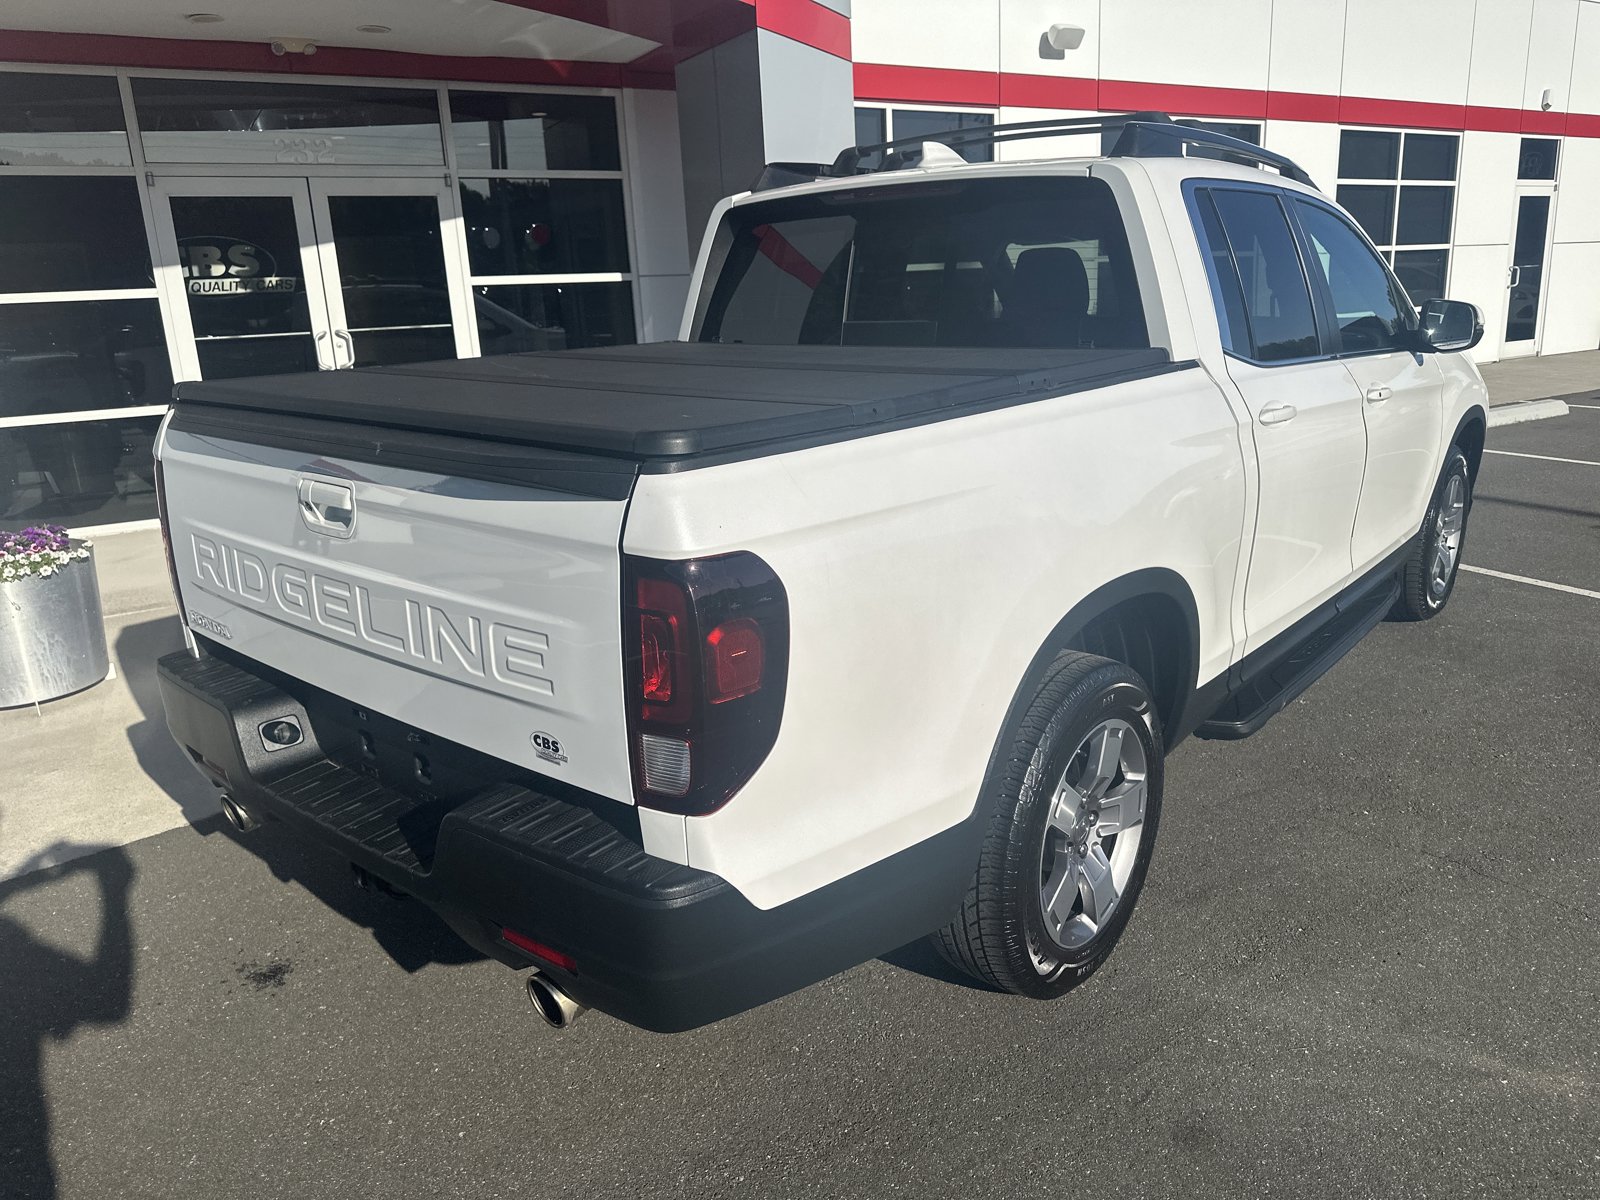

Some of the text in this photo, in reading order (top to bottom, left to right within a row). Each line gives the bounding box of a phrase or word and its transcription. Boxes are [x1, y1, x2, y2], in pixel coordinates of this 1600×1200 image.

[181, 245, 260, 277] BS
[190, 279, 294, 293] QUALITY CARS
[190, 532, 555, 697] RIDGELINE
[533, 734, 560, 753] CBS
